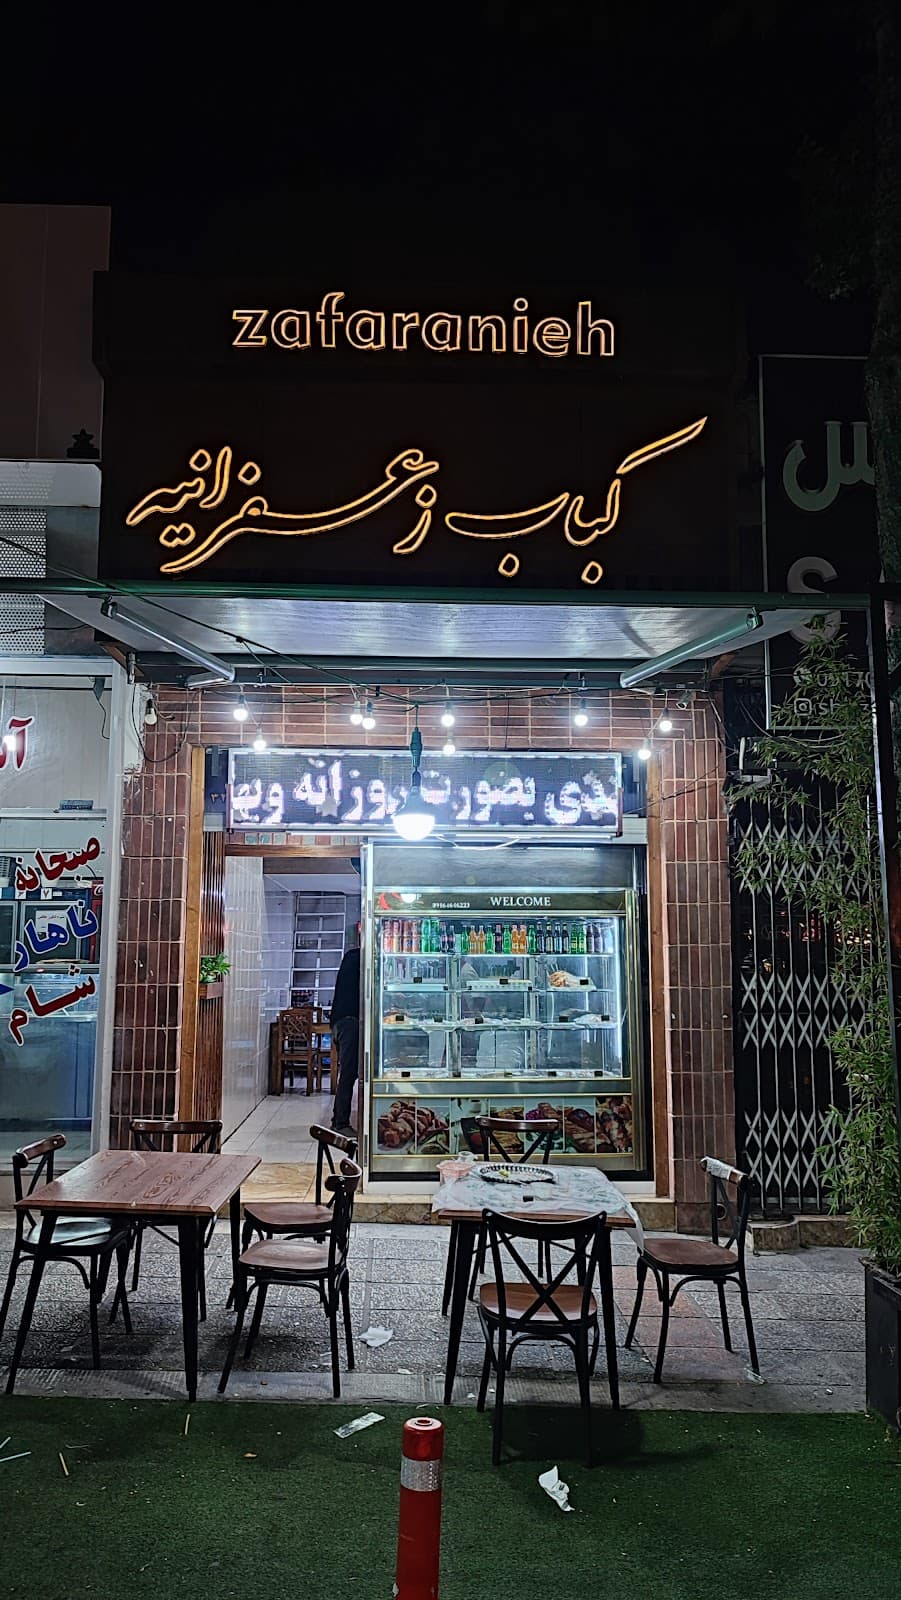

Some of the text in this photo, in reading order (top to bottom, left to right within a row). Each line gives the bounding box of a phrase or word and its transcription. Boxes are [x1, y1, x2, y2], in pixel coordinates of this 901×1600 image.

[233, 291, 615, 357] zafaranieh
[445, 416, 708, 585] کباب
[15, 836, 101, 892] صبحانه
[13, 899, 99, 973] ناهار
[490, 896, 551, 907] WELCOME
[8, 964, 97, 1046] شام
